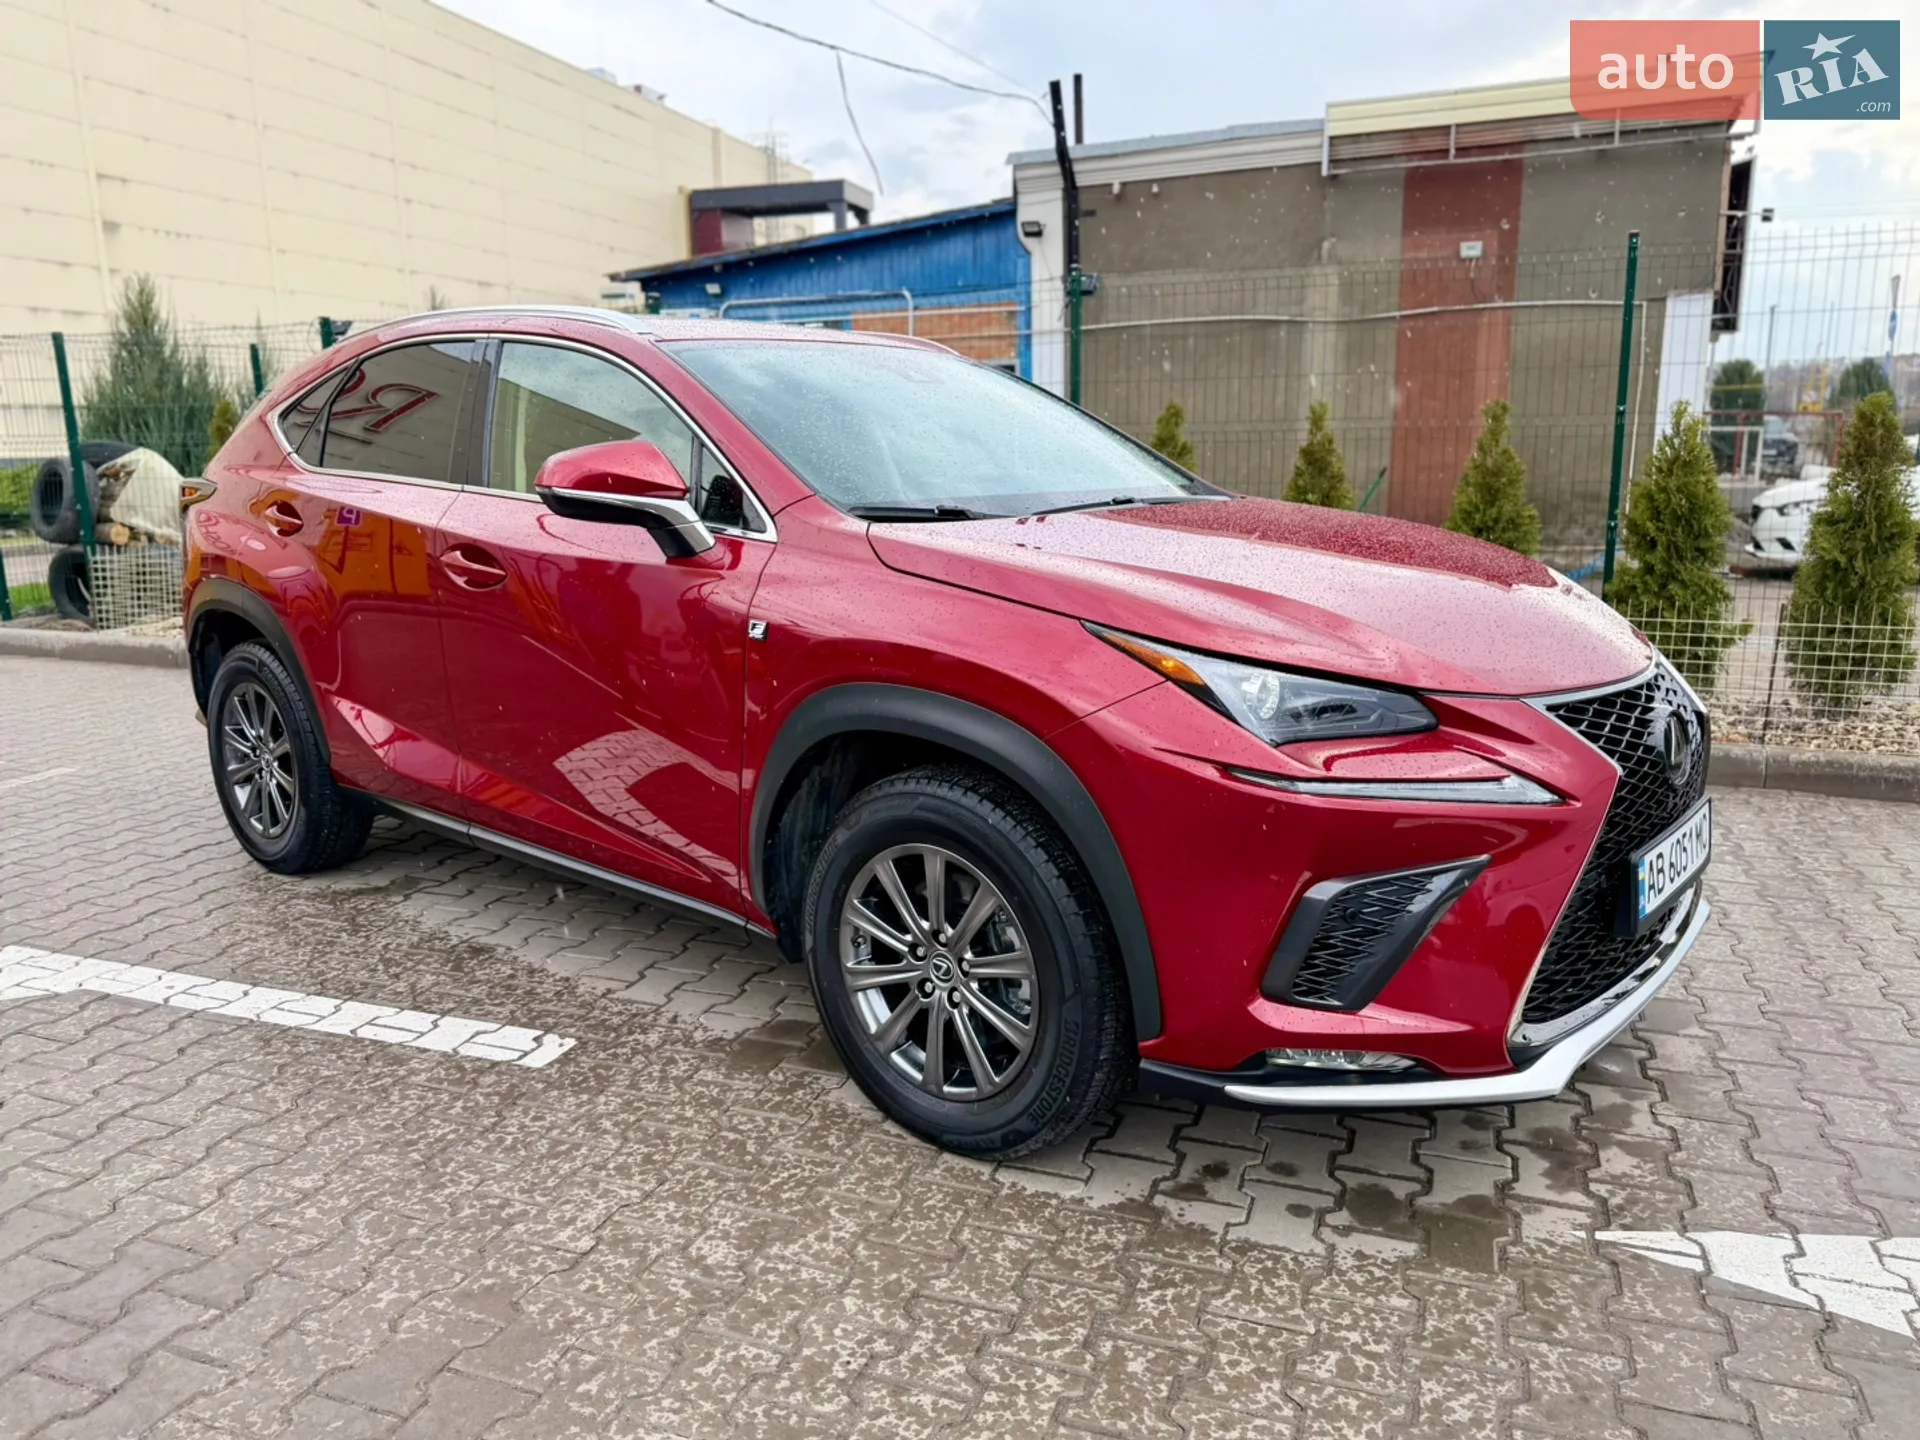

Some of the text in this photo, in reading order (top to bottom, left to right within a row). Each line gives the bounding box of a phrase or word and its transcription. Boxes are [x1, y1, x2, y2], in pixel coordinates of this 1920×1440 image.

[1647, 851, 1666, 905] AB
[1669, 826, 1694, 885] 6051
[1027, 1017, 1080, 1128] BRIDGESTONE
